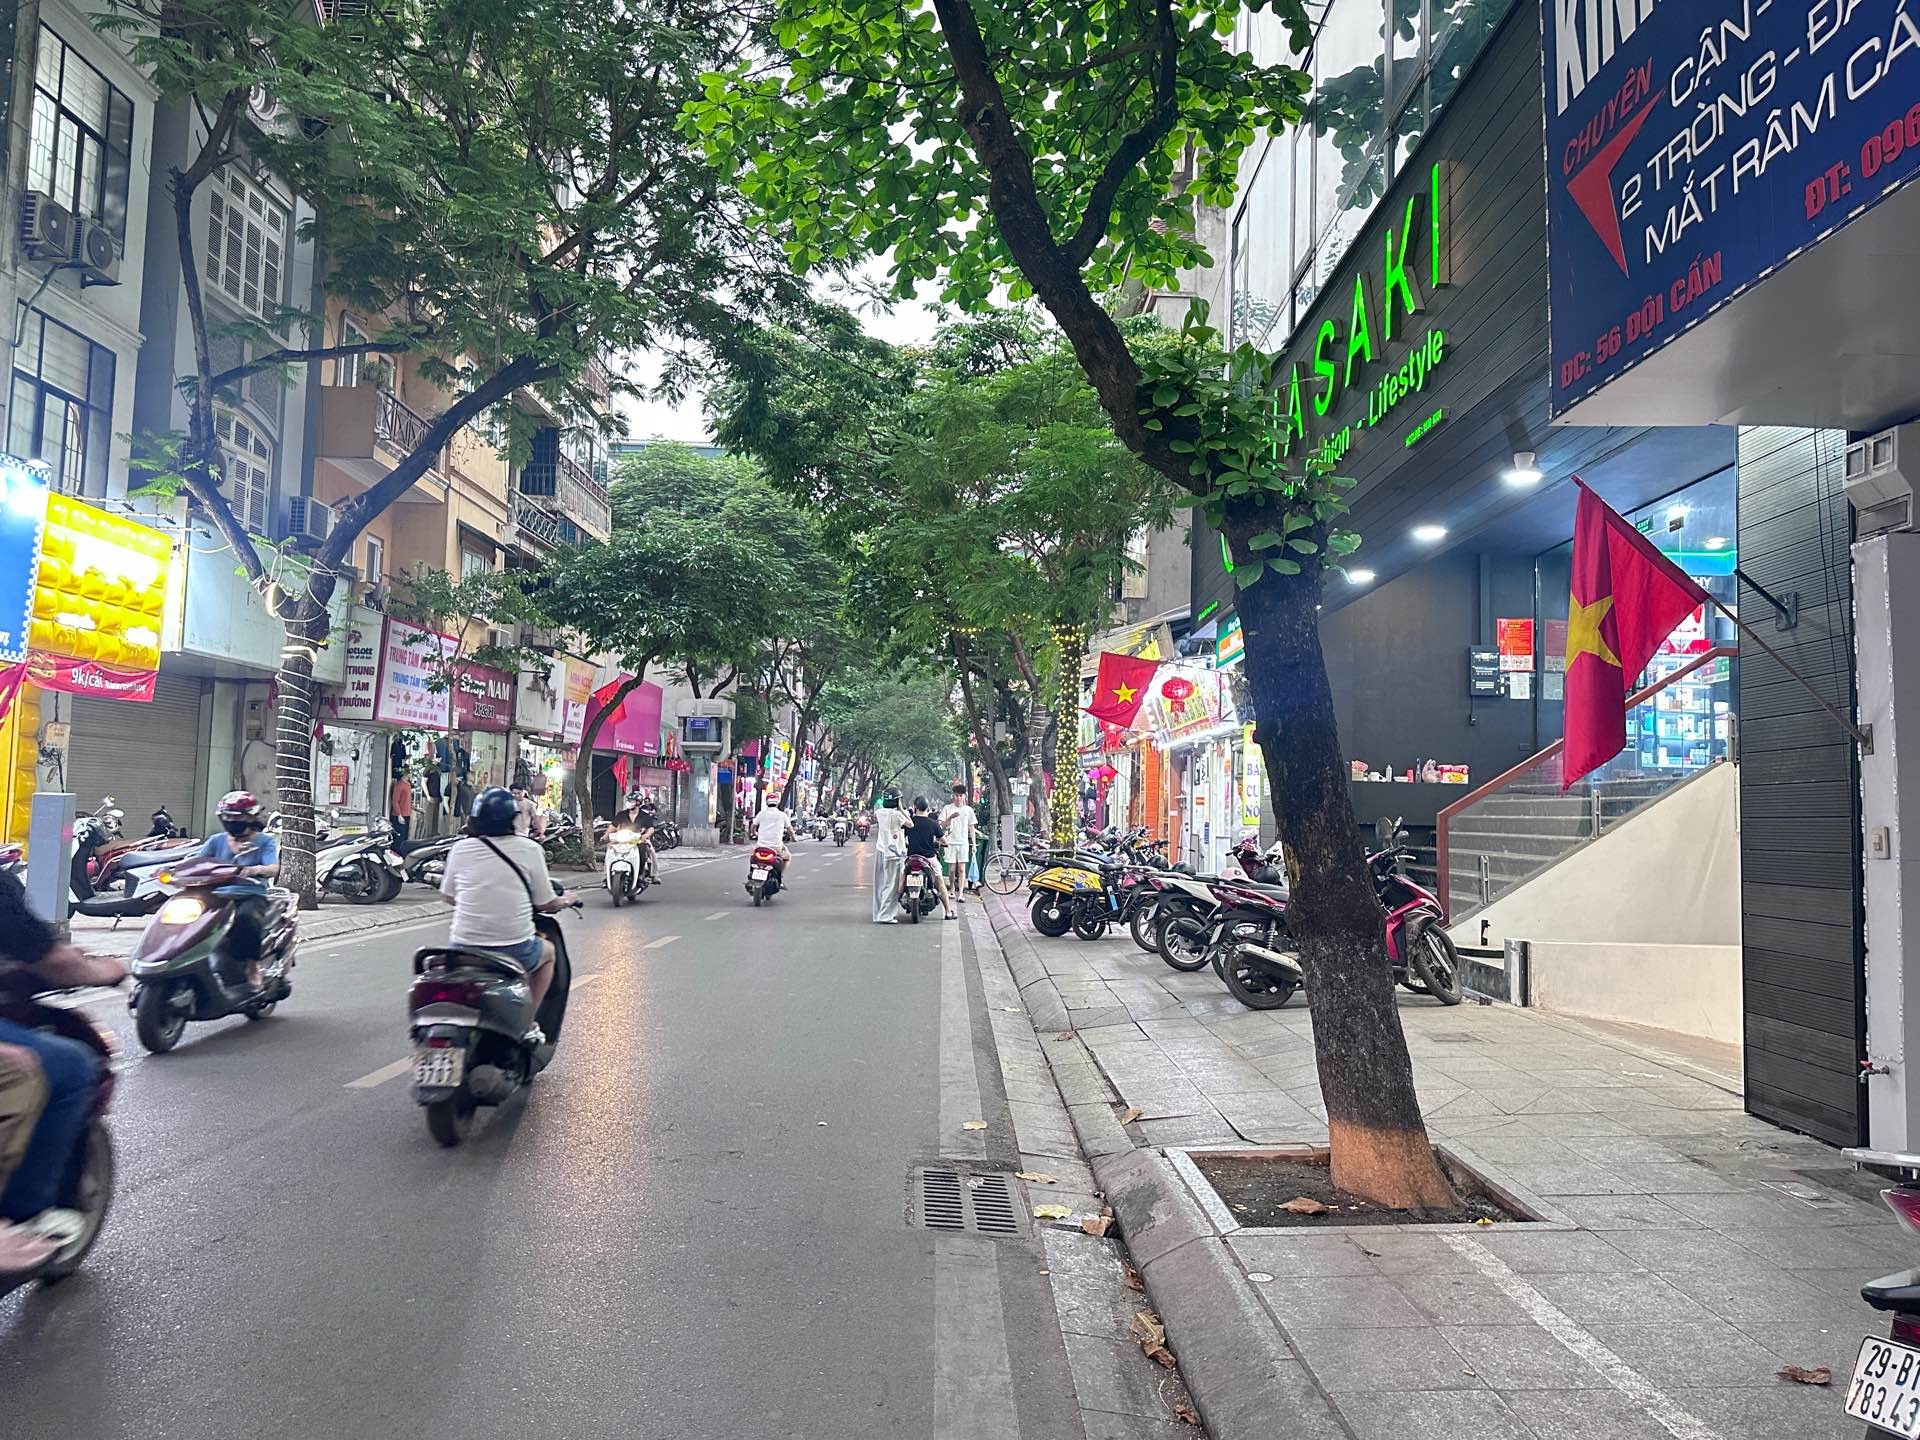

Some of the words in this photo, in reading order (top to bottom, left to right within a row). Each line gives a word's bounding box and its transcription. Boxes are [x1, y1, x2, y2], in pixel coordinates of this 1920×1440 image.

[1671, 0, 1750, 108] CẬN
[1562, 57, 1653, 175] CHUYÊN
[1622, 173, 1642, 221] 2
[1647, 50, 1776, 191] TRÒNG
[1644, 164, 1726, 264] MẮT
[1732, 72, 1836, 195] RÂM
[1804, 160, 1850, 220] ĐT:
[1561, 351, 1591, 388] ĐC:
[1596, 326, 1621, 364] 56
[1626, 297, 1664, 343] ĐỘI
[1670, 251, 1722, 312] CẤN
[1305, 425, 1350, 476] hion
[1368, 328, 1444, 427] Lifestyle
[71, 667, 103, 689] 9k/cái
[347, 665, 375, 676] TRUNG
[351, 680, 370, 691] TÂM
[487, 679, 510, 701] NAM
[1848, 1377, 1920, 1432] 783.43
